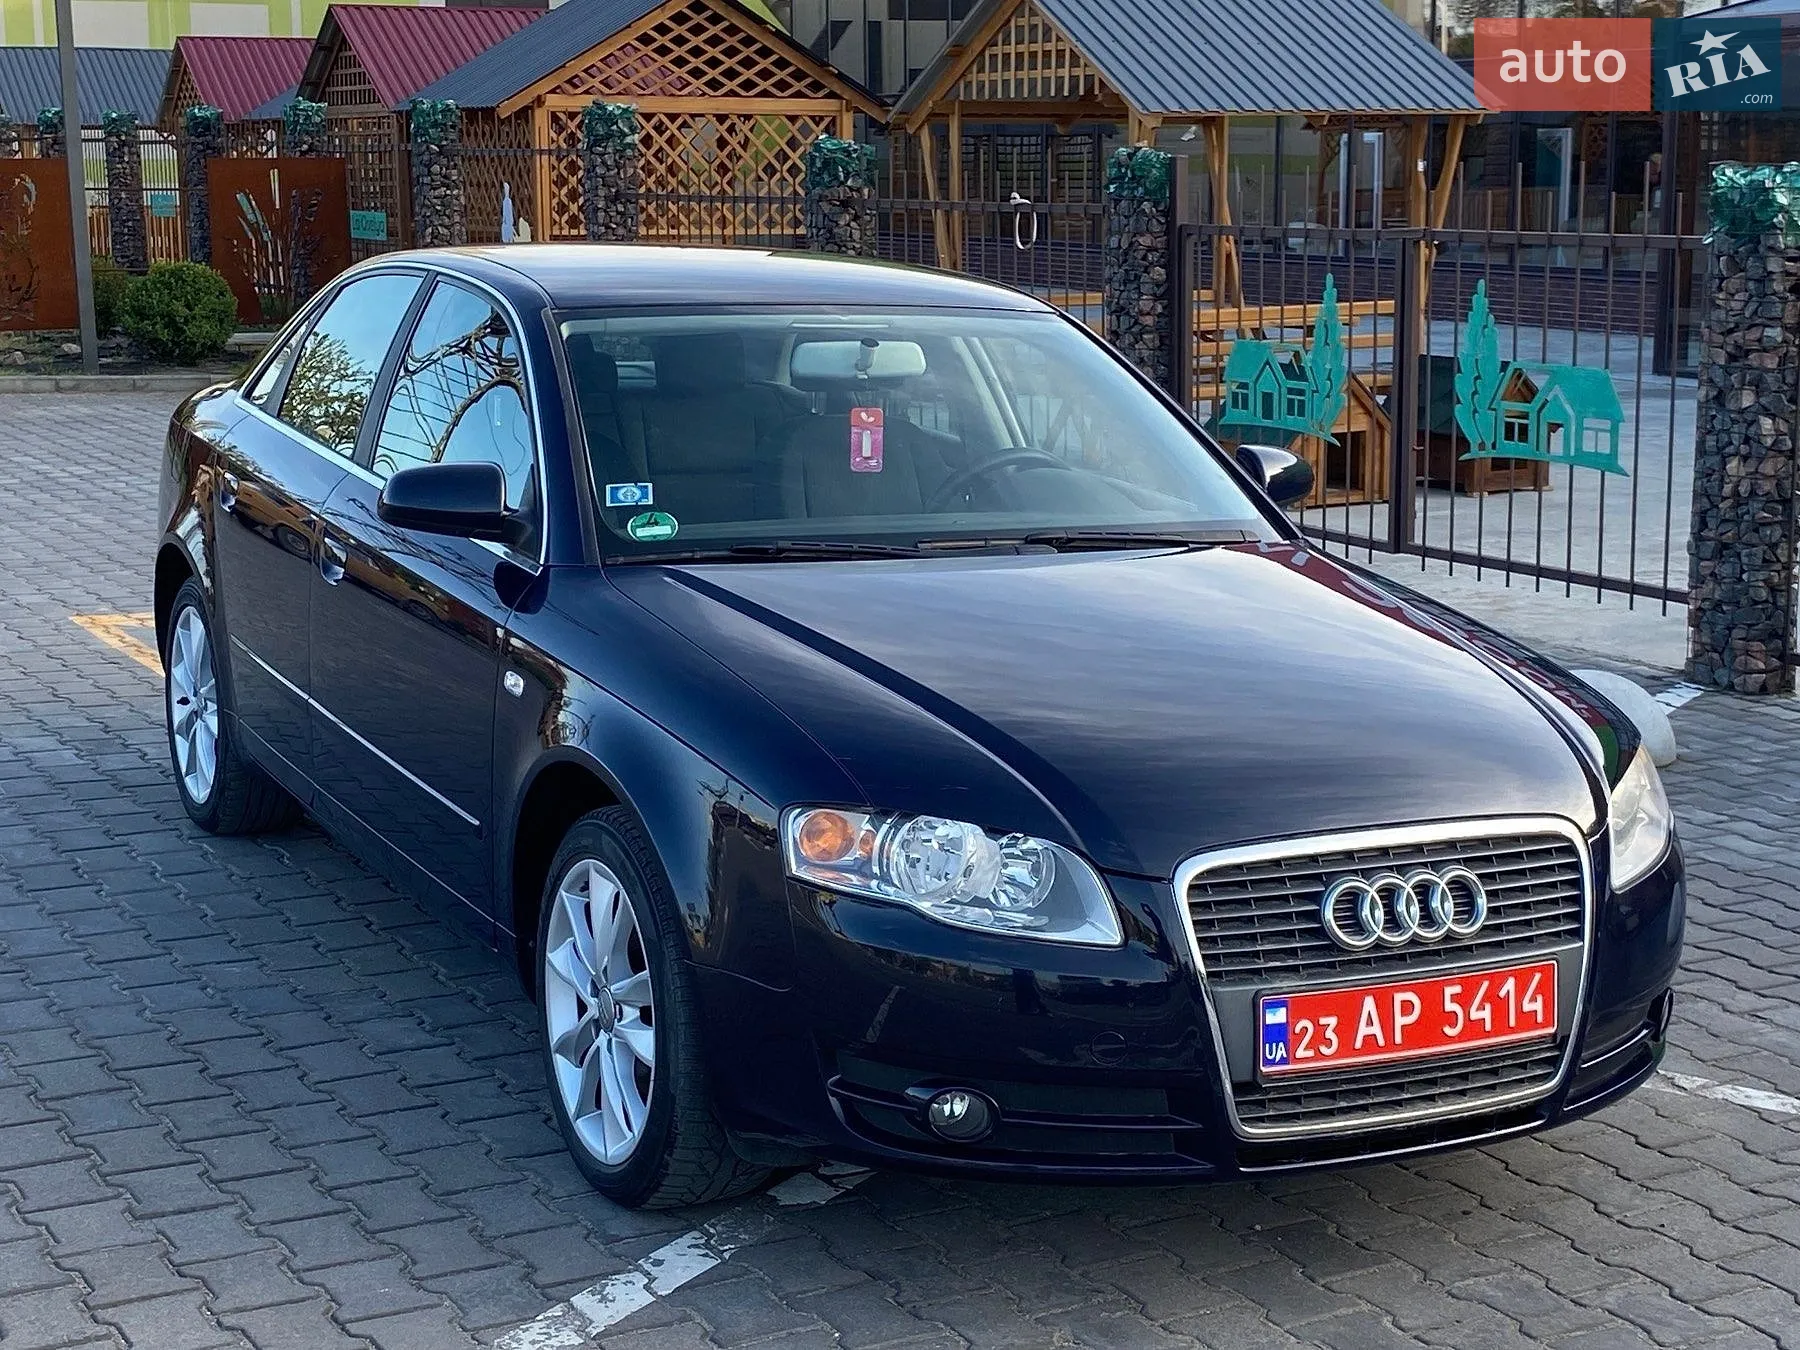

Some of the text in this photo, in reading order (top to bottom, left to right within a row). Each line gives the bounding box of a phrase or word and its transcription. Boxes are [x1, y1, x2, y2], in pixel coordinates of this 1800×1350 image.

[1294, 973, 1543, 1059] 23 AP 5414
[1265, 1041, 1287, 1063] UA
